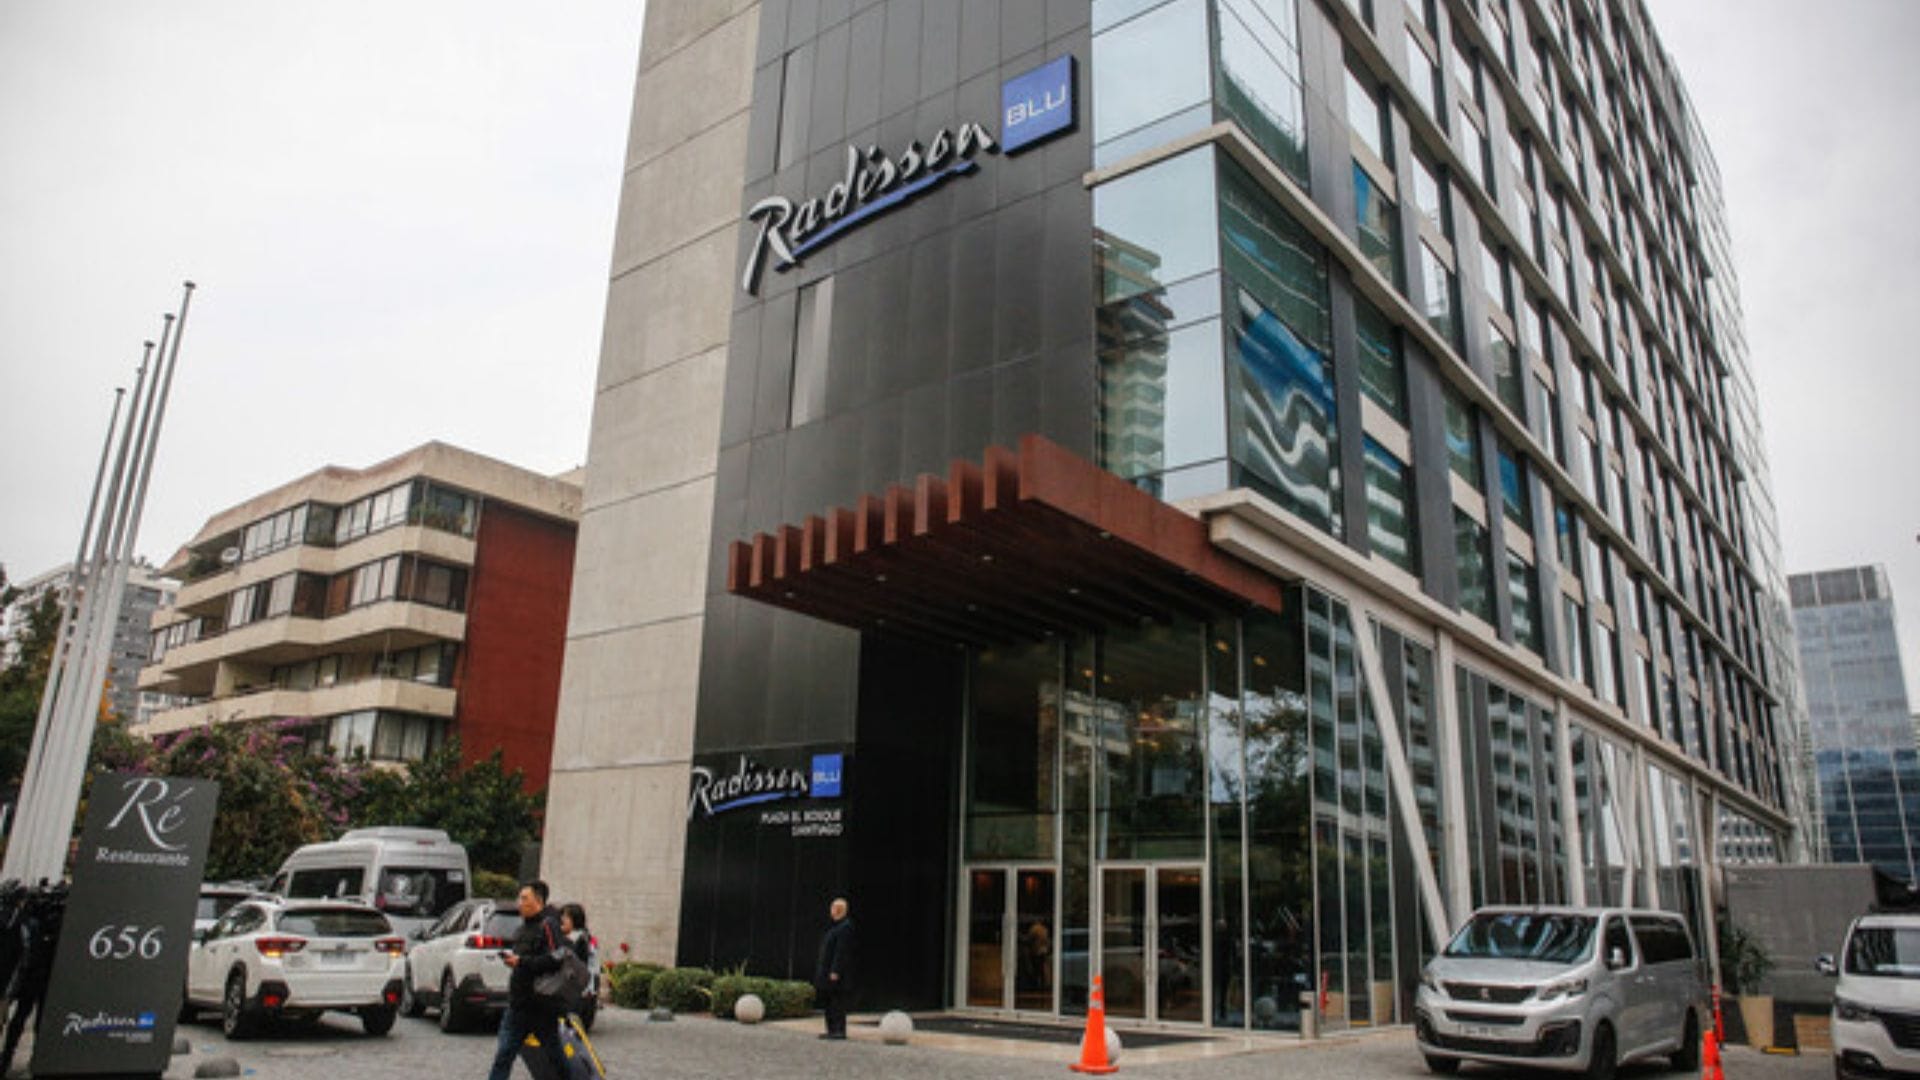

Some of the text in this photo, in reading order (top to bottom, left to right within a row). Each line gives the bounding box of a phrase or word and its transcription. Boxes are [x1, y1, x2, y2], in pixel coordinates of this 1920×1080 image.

[743, 84, 1067, 293] Radisson BLU
[106, 778, 195, 851] Ré
[688, 754, 841, 821] Radisson BLU
[96, 847, 190, 866] Restaurante
[89, 925, 165, 959] 656
